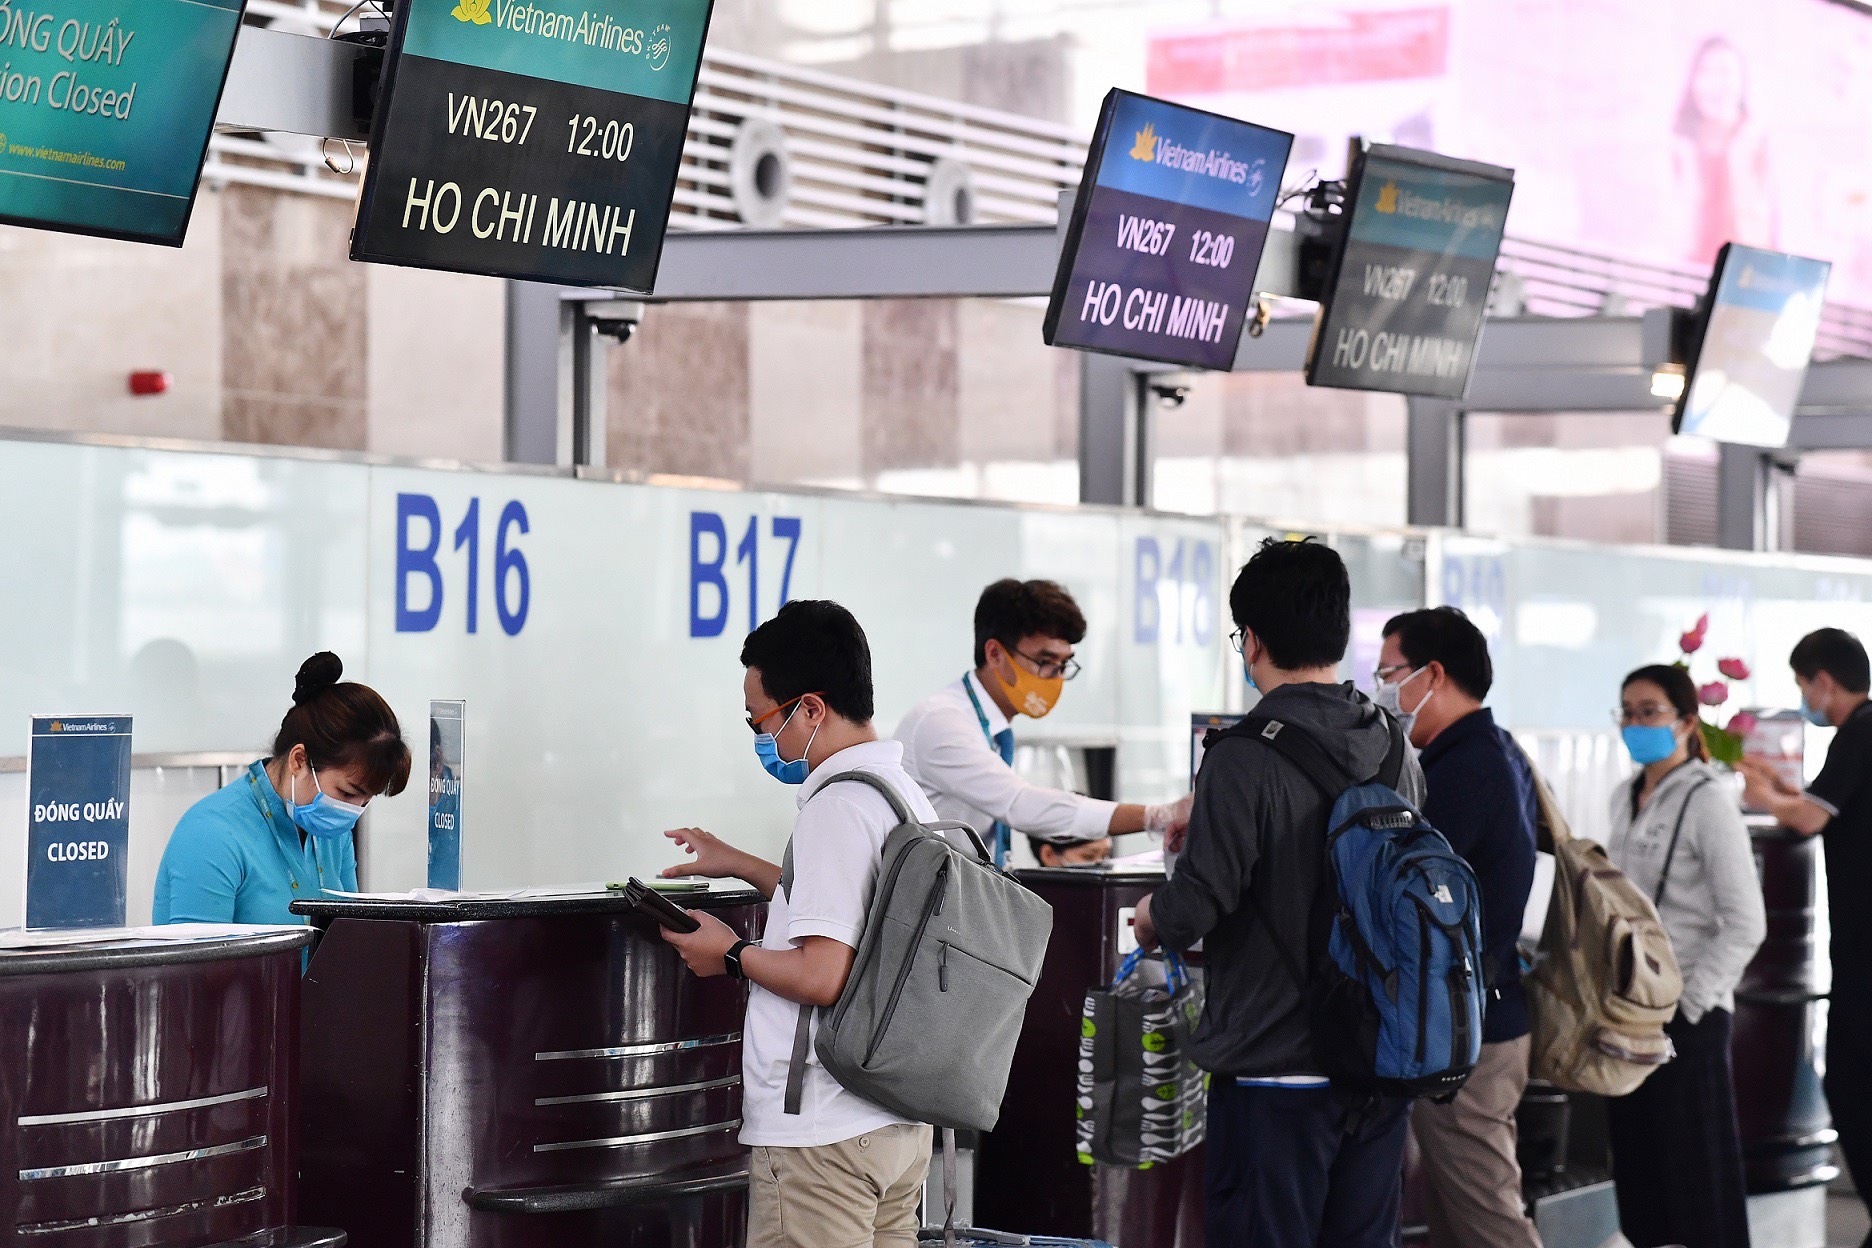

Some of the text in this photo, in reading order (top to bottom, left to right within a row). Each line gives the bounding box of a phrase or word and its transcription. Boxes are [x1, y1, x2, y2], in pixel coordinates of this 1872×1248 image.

[0, 62, 137, 120] ion Closed
[447, 92, 635, 163] VN267 12:00
[8, 143, 126, 171] www.vietnamairlines.com
[401, 177, 636, 257] HO CHI MINH
[1116, 214, 1236, 269] VN267 12:00
[1080, 280, 1230, 344] HO CHI MINH
[1332, 328, 1464, 379] HO CHI MINH
[394, 492, 531, 637] B16
[689, 510, 801, 638] B17
[34, 800, 80, 823] ĐÓNG
[434, 811, 455, 830] CLOSED
[47, 841, 109, 862] CLOSED
